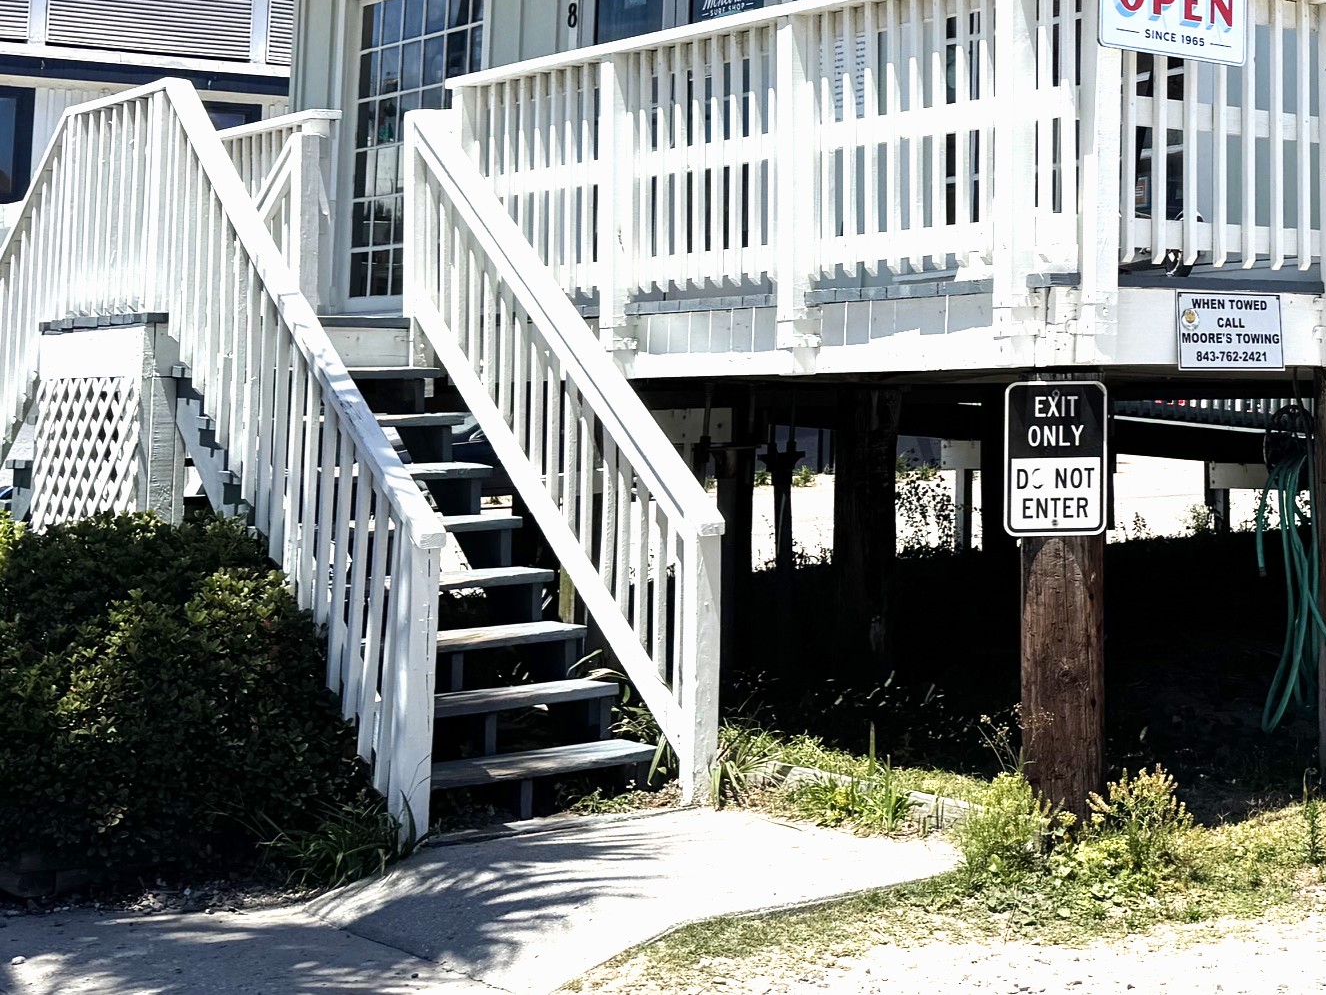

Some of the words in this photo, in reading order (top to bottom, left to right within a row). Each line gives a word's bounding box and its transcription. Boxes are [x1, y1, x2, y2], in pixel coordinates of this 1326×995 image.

[567, 2, 577, 28] 8
[710, 6, 725, 16] SURF
[728, 2, 745, 11] SHOP
[1144, 28, 1177, 43] SINCE
[1181, 34, 1205, 47] 1965
[1191, 298, 1225, 309] WHEN
[1229, 299, 1267, 311] TOWED
[1217, 317, 1245, 328] CALL
[1182, 333, 1232, 344] MOORE'S
[1236, 333, 1280, 344] TOWING
[1196, 351, 1267, 362] 843-762-2421
[1034, 395, 1078, 417] EXIT
[1028, 424, 1084, 447] ONLY
[1055, 467, 1095, 489] NOT
[1022, 497, 1089, 519] ENTER
